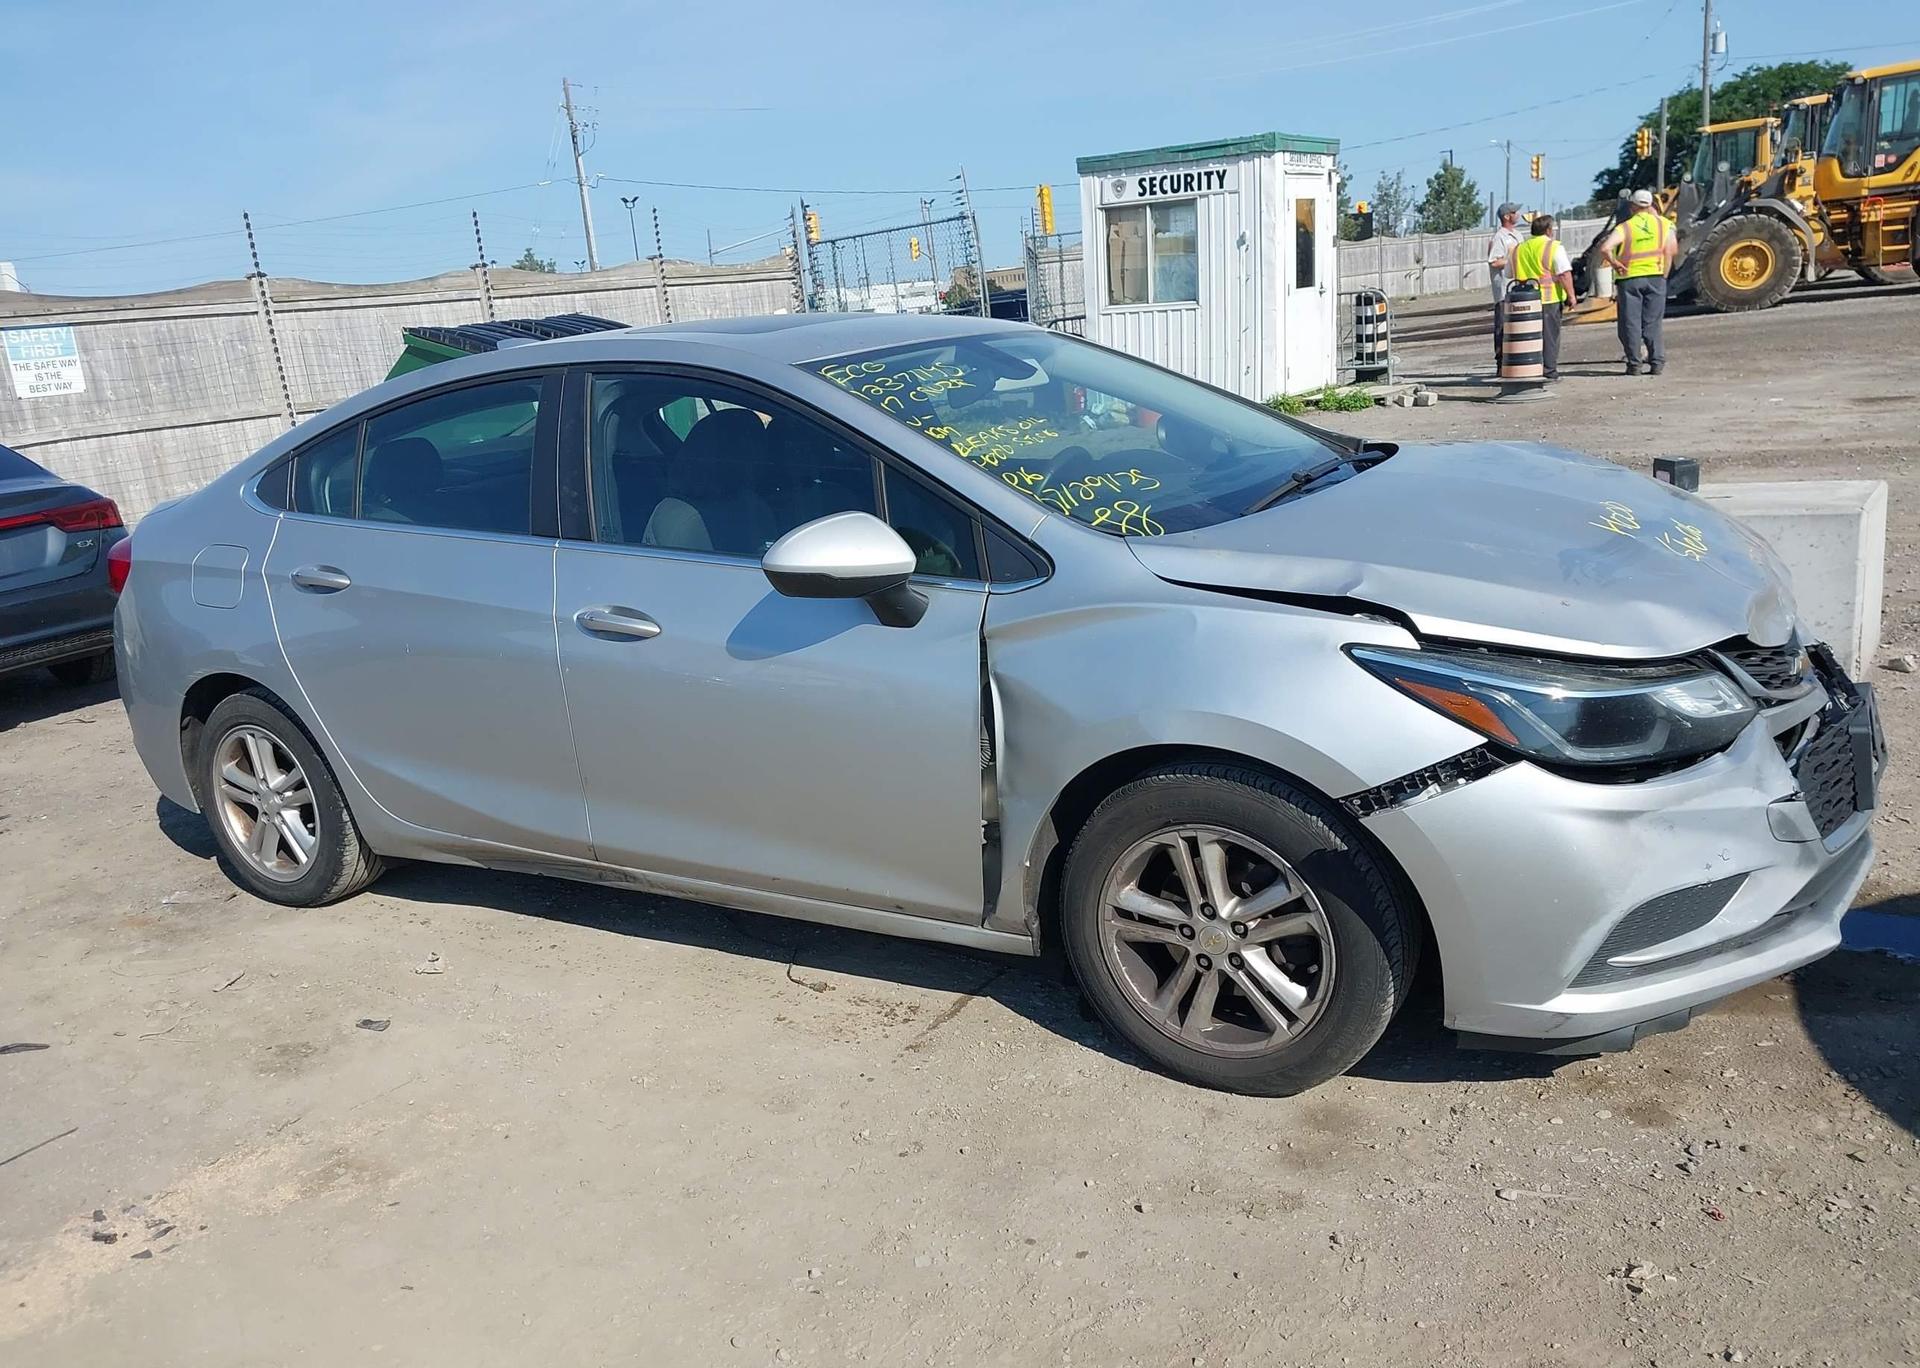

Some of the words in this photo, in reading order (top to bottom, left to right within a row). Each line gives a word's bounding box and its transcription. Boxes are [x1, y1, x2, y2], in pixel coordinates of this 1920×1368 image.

[1137, 169, 1227, 197] SECURITY
[8, 326, 67, 344] SAFETY
[21, 343, 64, 359] FIRST
[13, 362, 32, 372] THE
[34, 360, 58, 371] SAFE
[59, 359, 78, 368] WAY
[34, 372, 44, 382] IS
[45, 371, 63, 381] THE
[29, 383, 53, 394] BEST
[54, 381, 73, 391] WAY
[76, 539, 94, 548] EX
